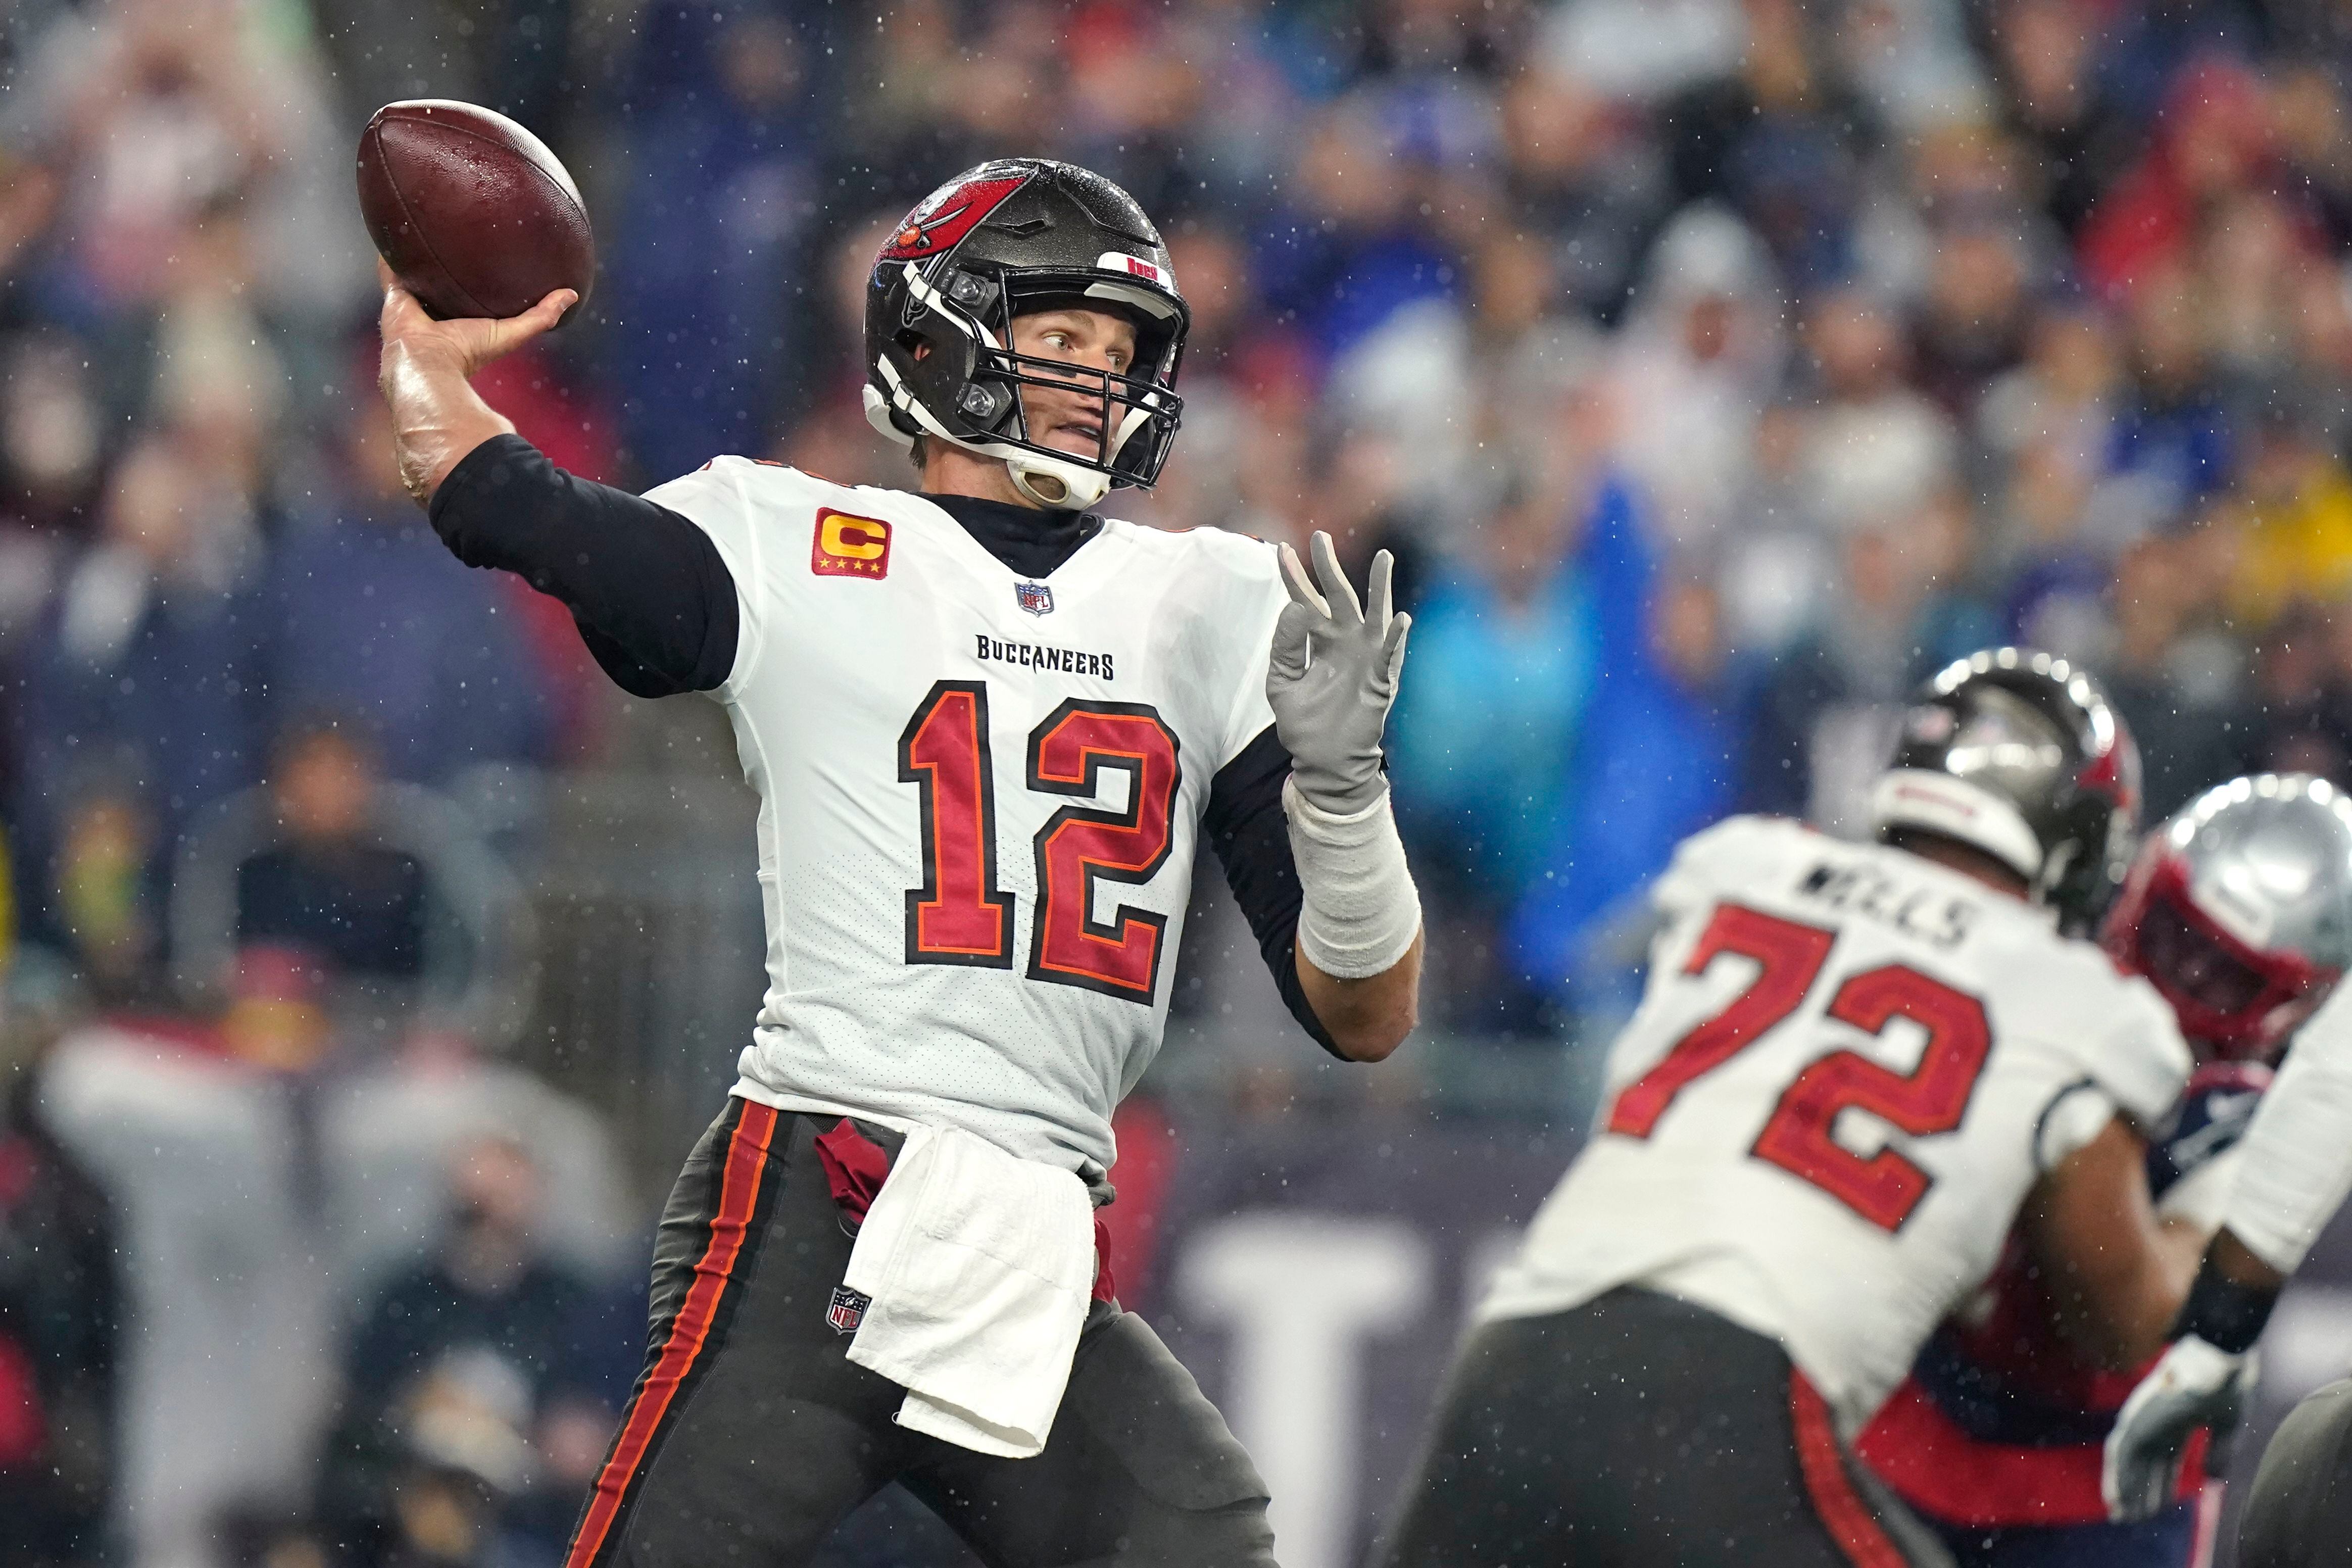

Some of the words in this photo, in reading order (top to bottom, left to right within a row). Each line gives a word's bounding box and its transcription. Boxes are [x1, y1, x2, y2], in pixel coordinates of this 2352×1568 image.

[821, 515, 886, 560] C
[1023, 593, 1048, 609] NFL
[975, 634, 1113, 680] BUCCANEERS
[898, 680, 1181, 1006] 12
[1606, 902, 1993, 1234] 72
[831, 1305, 857, 1328] NFL
